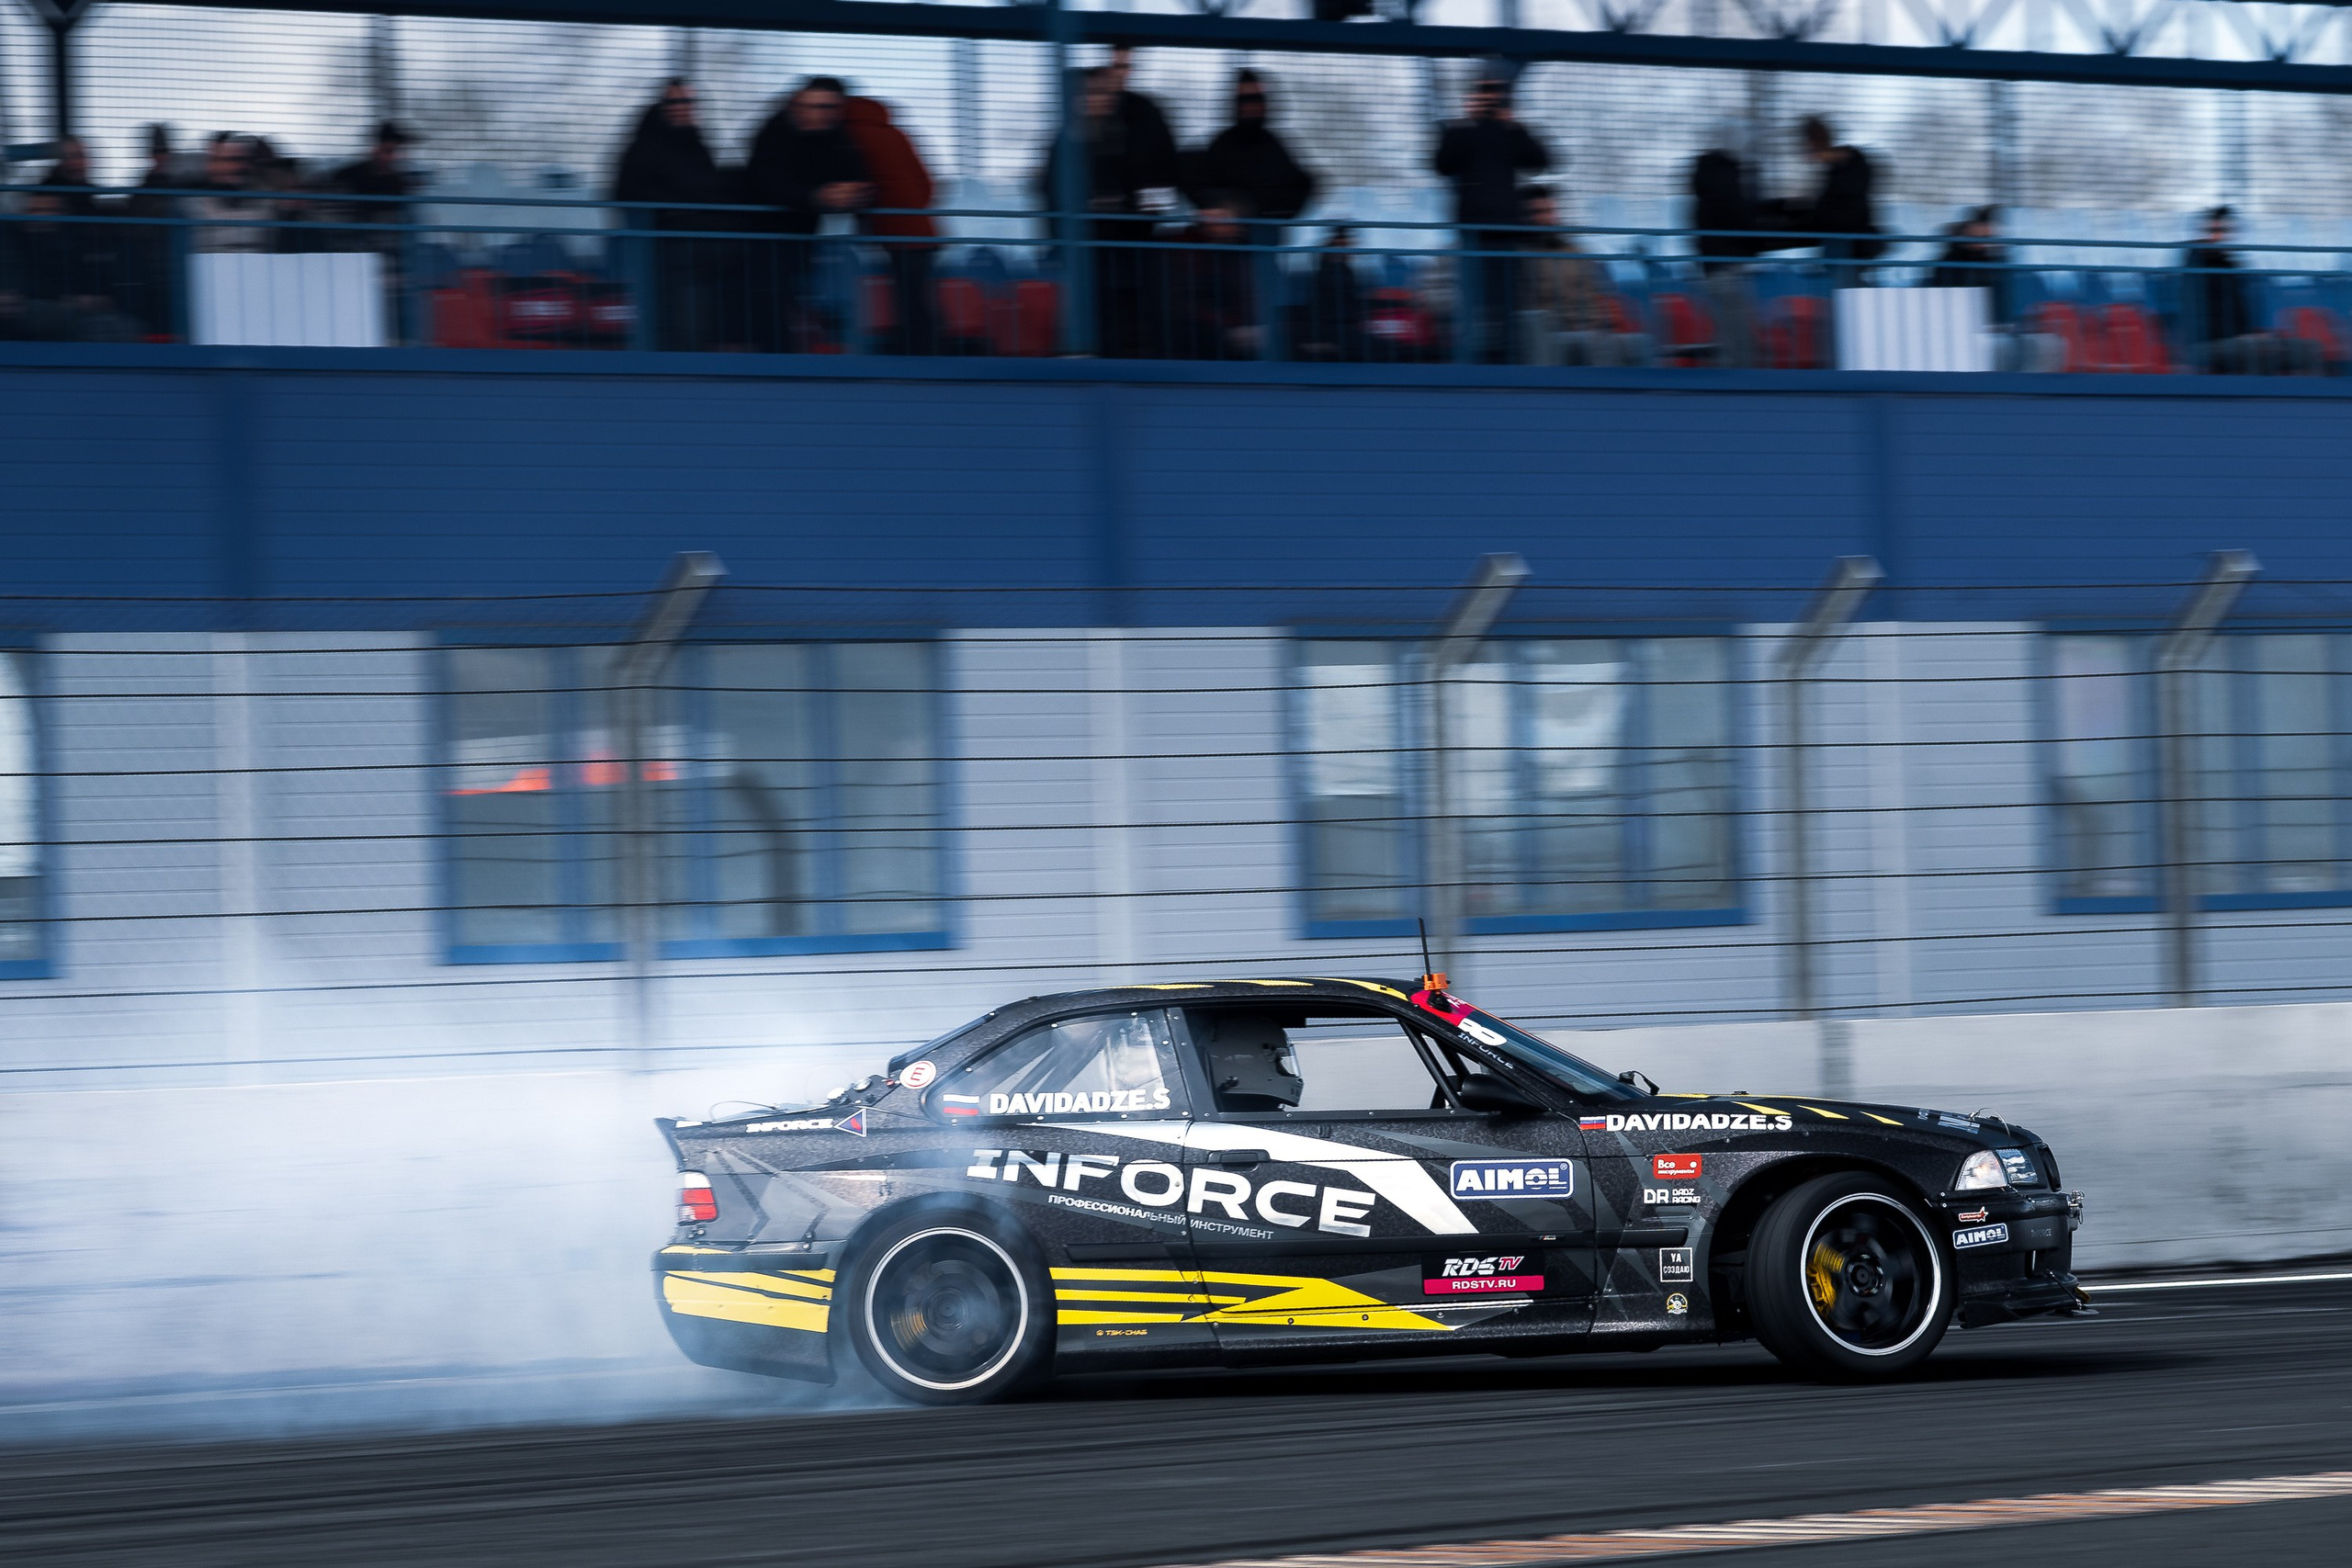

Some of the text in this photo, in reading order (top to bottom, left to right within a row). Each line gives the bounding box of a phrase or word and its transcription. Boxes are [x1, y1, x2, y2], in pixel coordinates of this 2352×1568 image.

[989, 1088, 1171, 1114] DAVIDADZE.S
[1606, 1113, 1792, 1131] DAVIDADZE.S
[1657, 1159, 1676, 1169] Все
[1455, 1168, 1567, 1191] AIMOL
[966, 1148, 1376, 1237] INFORCE
[1644, 1189, 1669, 1204] DR
[1047, 1194, 1275, 1240] ПРОФЕССИОНАЛЬНЫЙ ИНСТРУМЕНТ
[1956, 1227, 2006, 1246] AIMOL
[1442, 1257, 1498, 1277] RDS
[1663, 1265, 1690, 1274] СОЗДАЮ
[1452, 1279, 1517, 1290] RDSTV.RU
